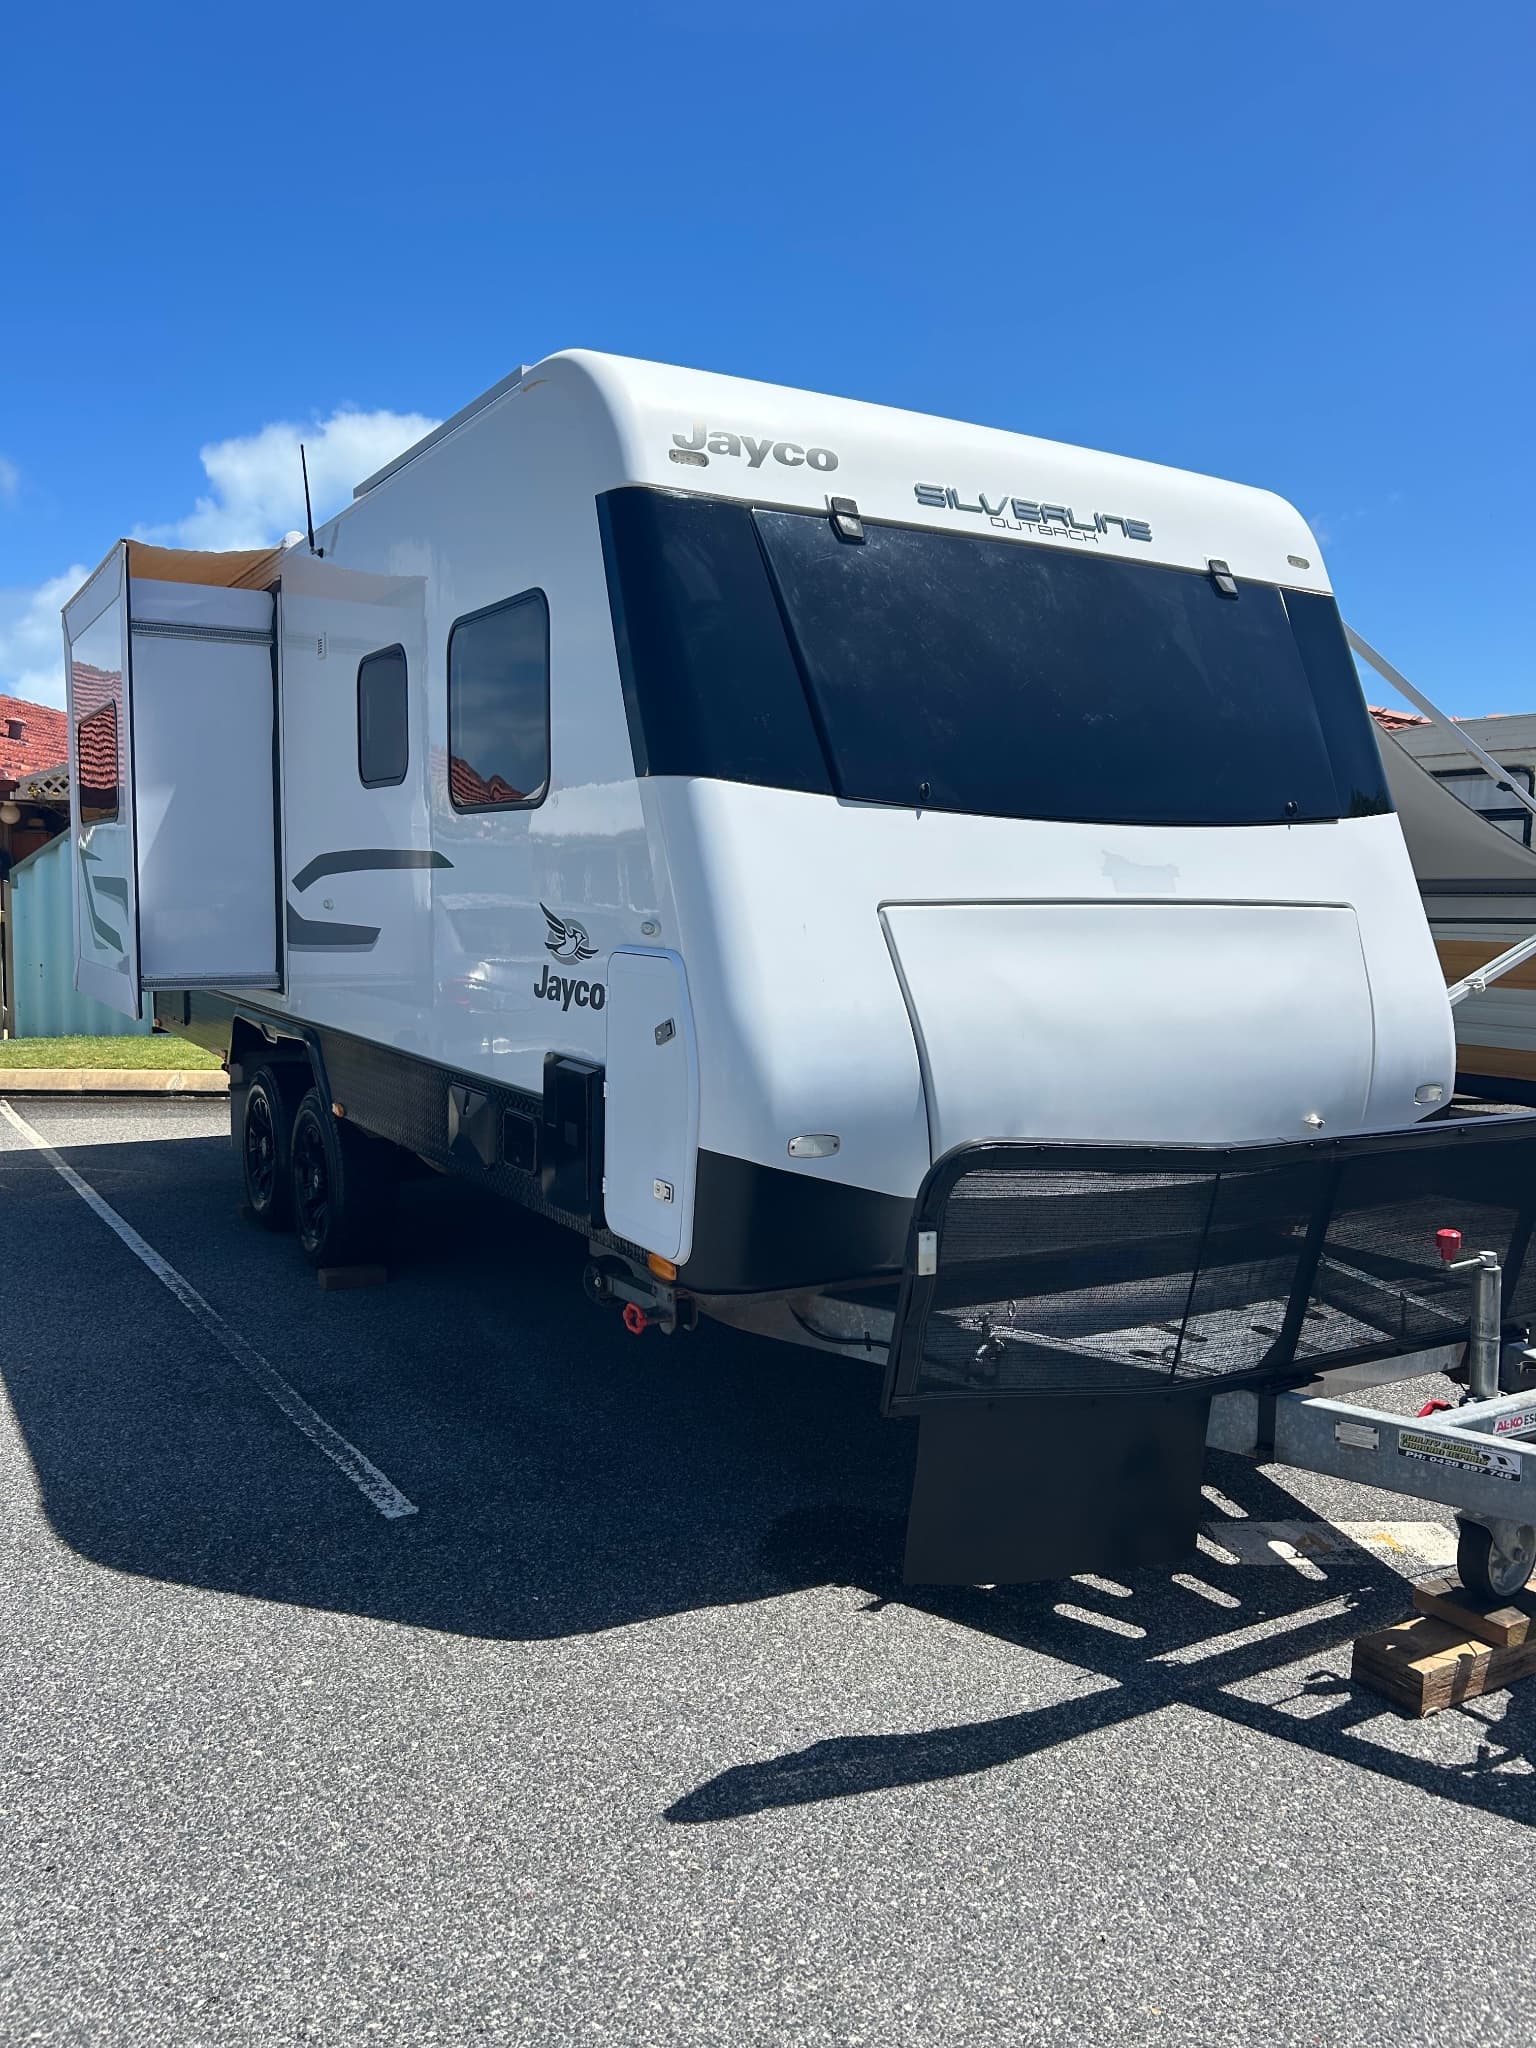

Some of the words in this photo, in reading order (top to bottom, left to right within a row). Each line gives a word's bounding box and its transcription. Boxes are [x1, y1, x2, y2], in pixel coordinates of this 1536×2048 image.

[672, 423, 839, 472] Jayco
[914, 482, 1152, 543] SILVERLINE
[990, 516, 1099, 545] OUTBACK
[533, 964, 606, 1012] Jayco
[1523, 1412, 1536, 1426] ES
